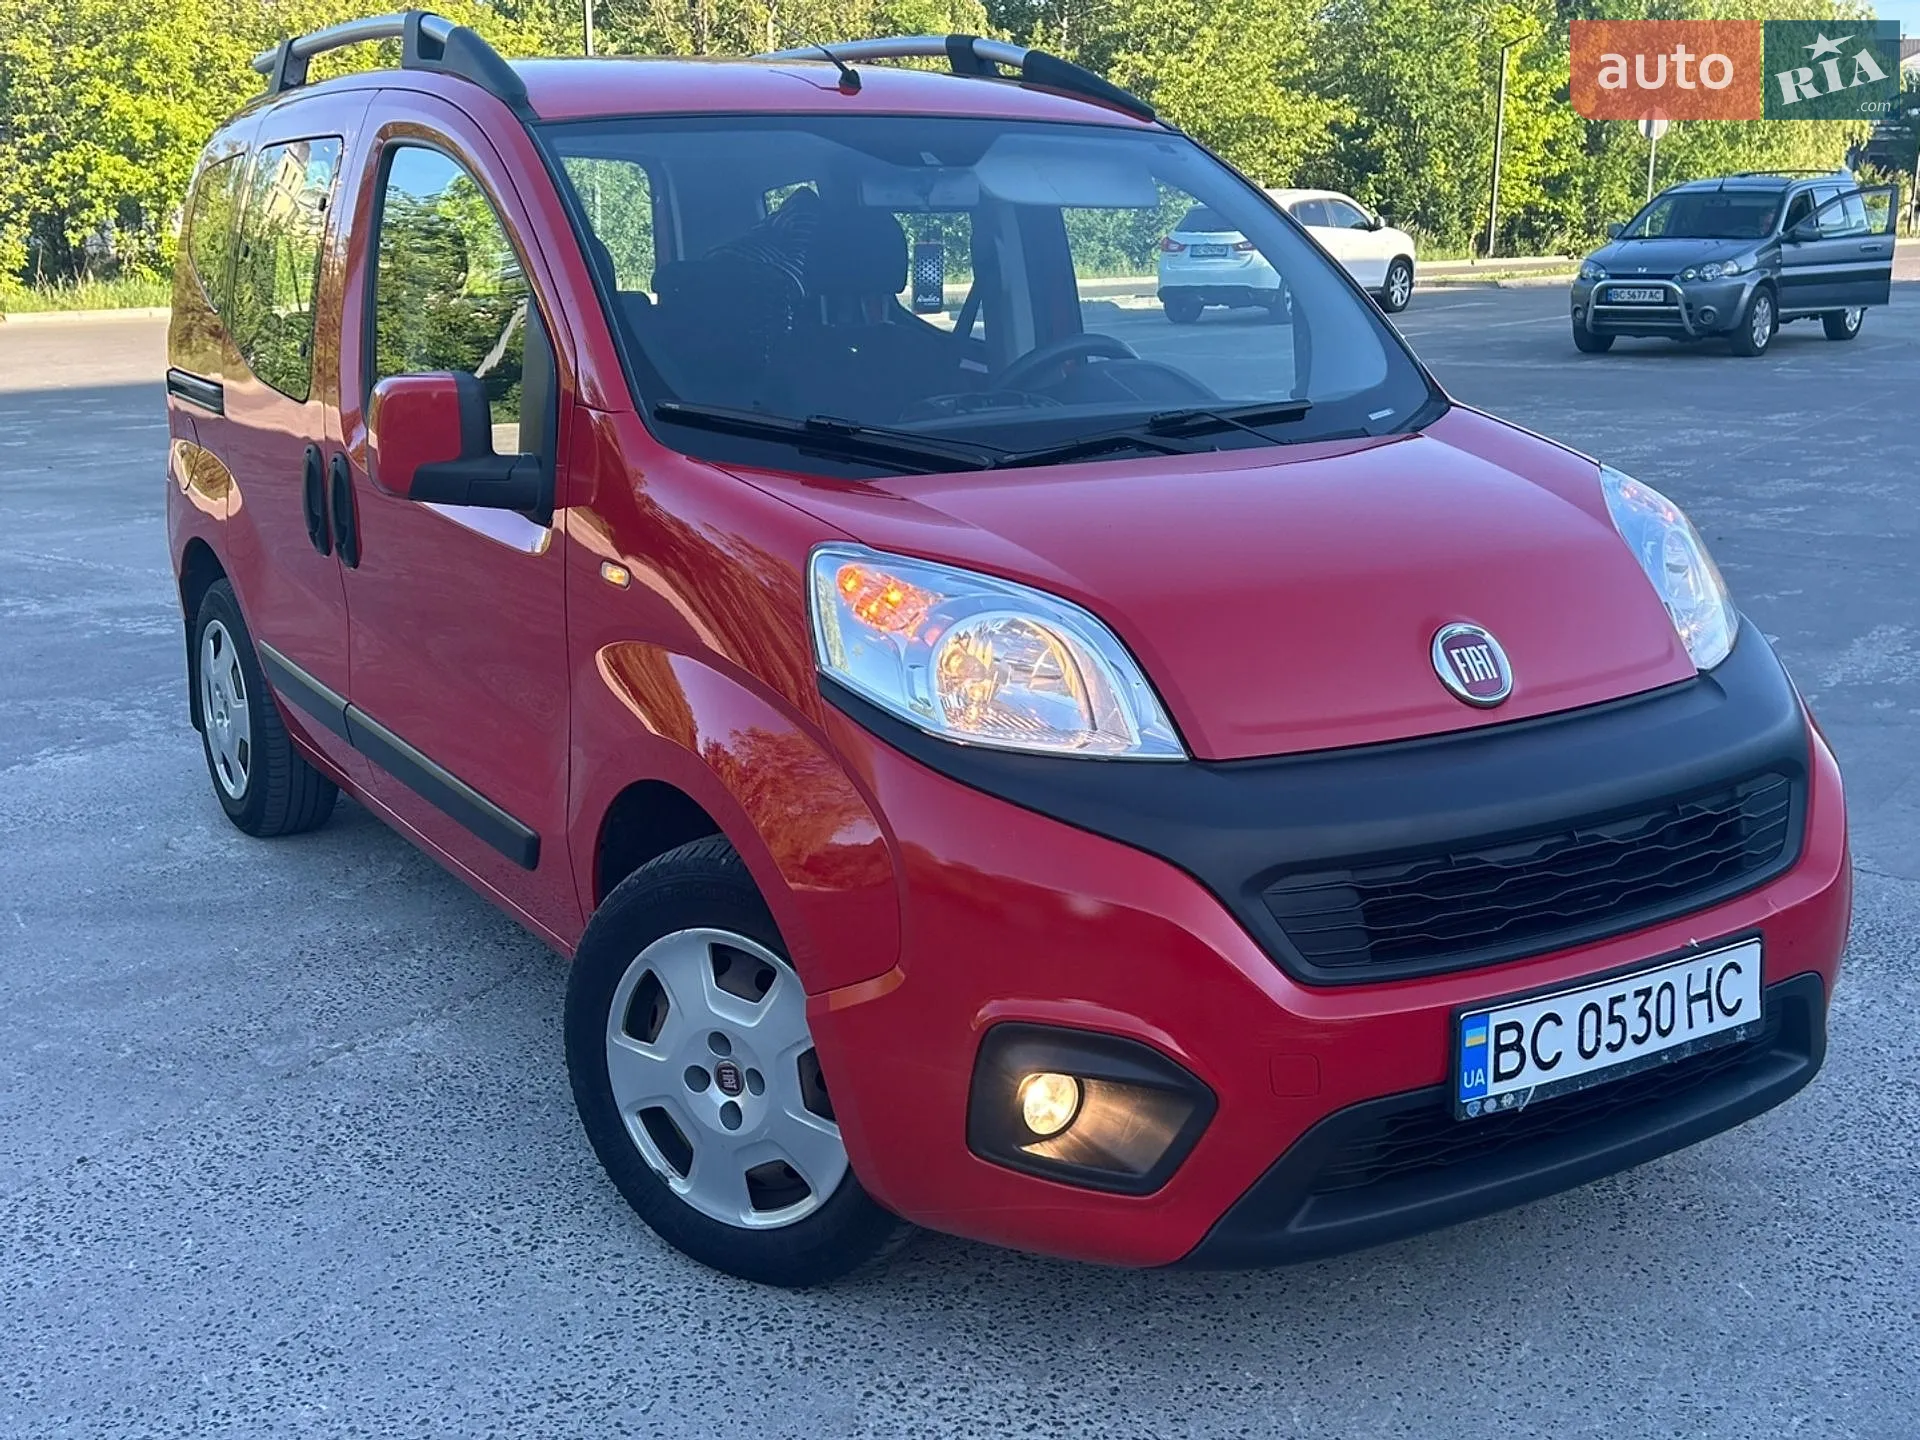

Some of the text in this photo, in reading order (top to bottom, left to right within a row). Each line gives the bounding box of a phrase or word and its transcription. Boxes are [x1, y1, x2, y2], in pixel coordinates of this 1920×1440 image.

[1627, 289, 1647, 300] 5677
[1648, 289, 1661, 300] AC
[1449, 643, 1499, 684] FIAT
[1492, 961, 1743, 1083] BC 0530 HC
[1463, 1069, 1486, 1088] UA
